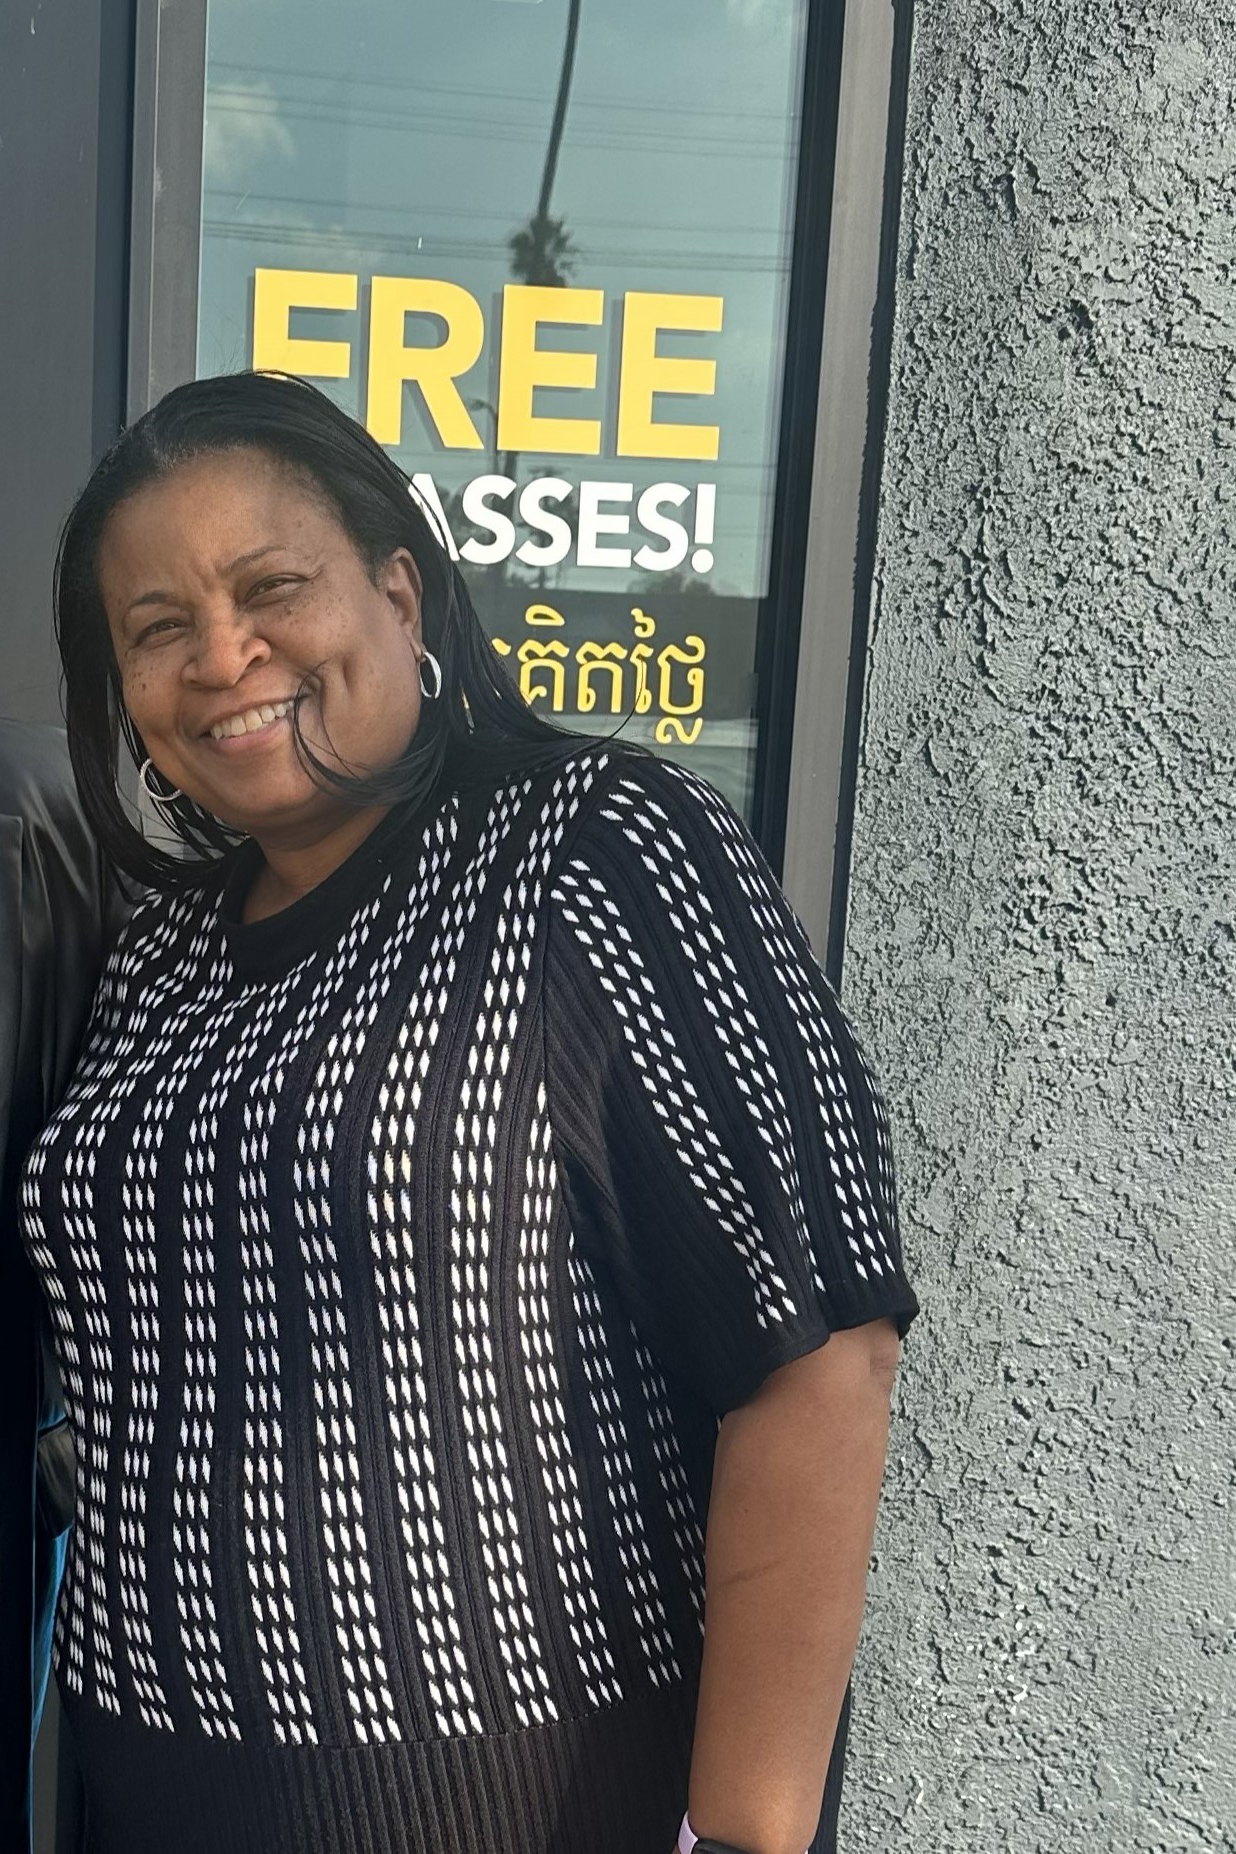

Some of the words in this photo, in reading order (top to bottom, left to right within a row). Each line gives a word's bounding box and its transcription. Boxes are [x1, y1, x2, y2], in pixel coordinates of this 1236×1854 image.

[252, 267, 724, 460] FREE
[404, 471, 716, 575] ASSES!
[491, 603, 707, 744] គិតថ្លៃ
